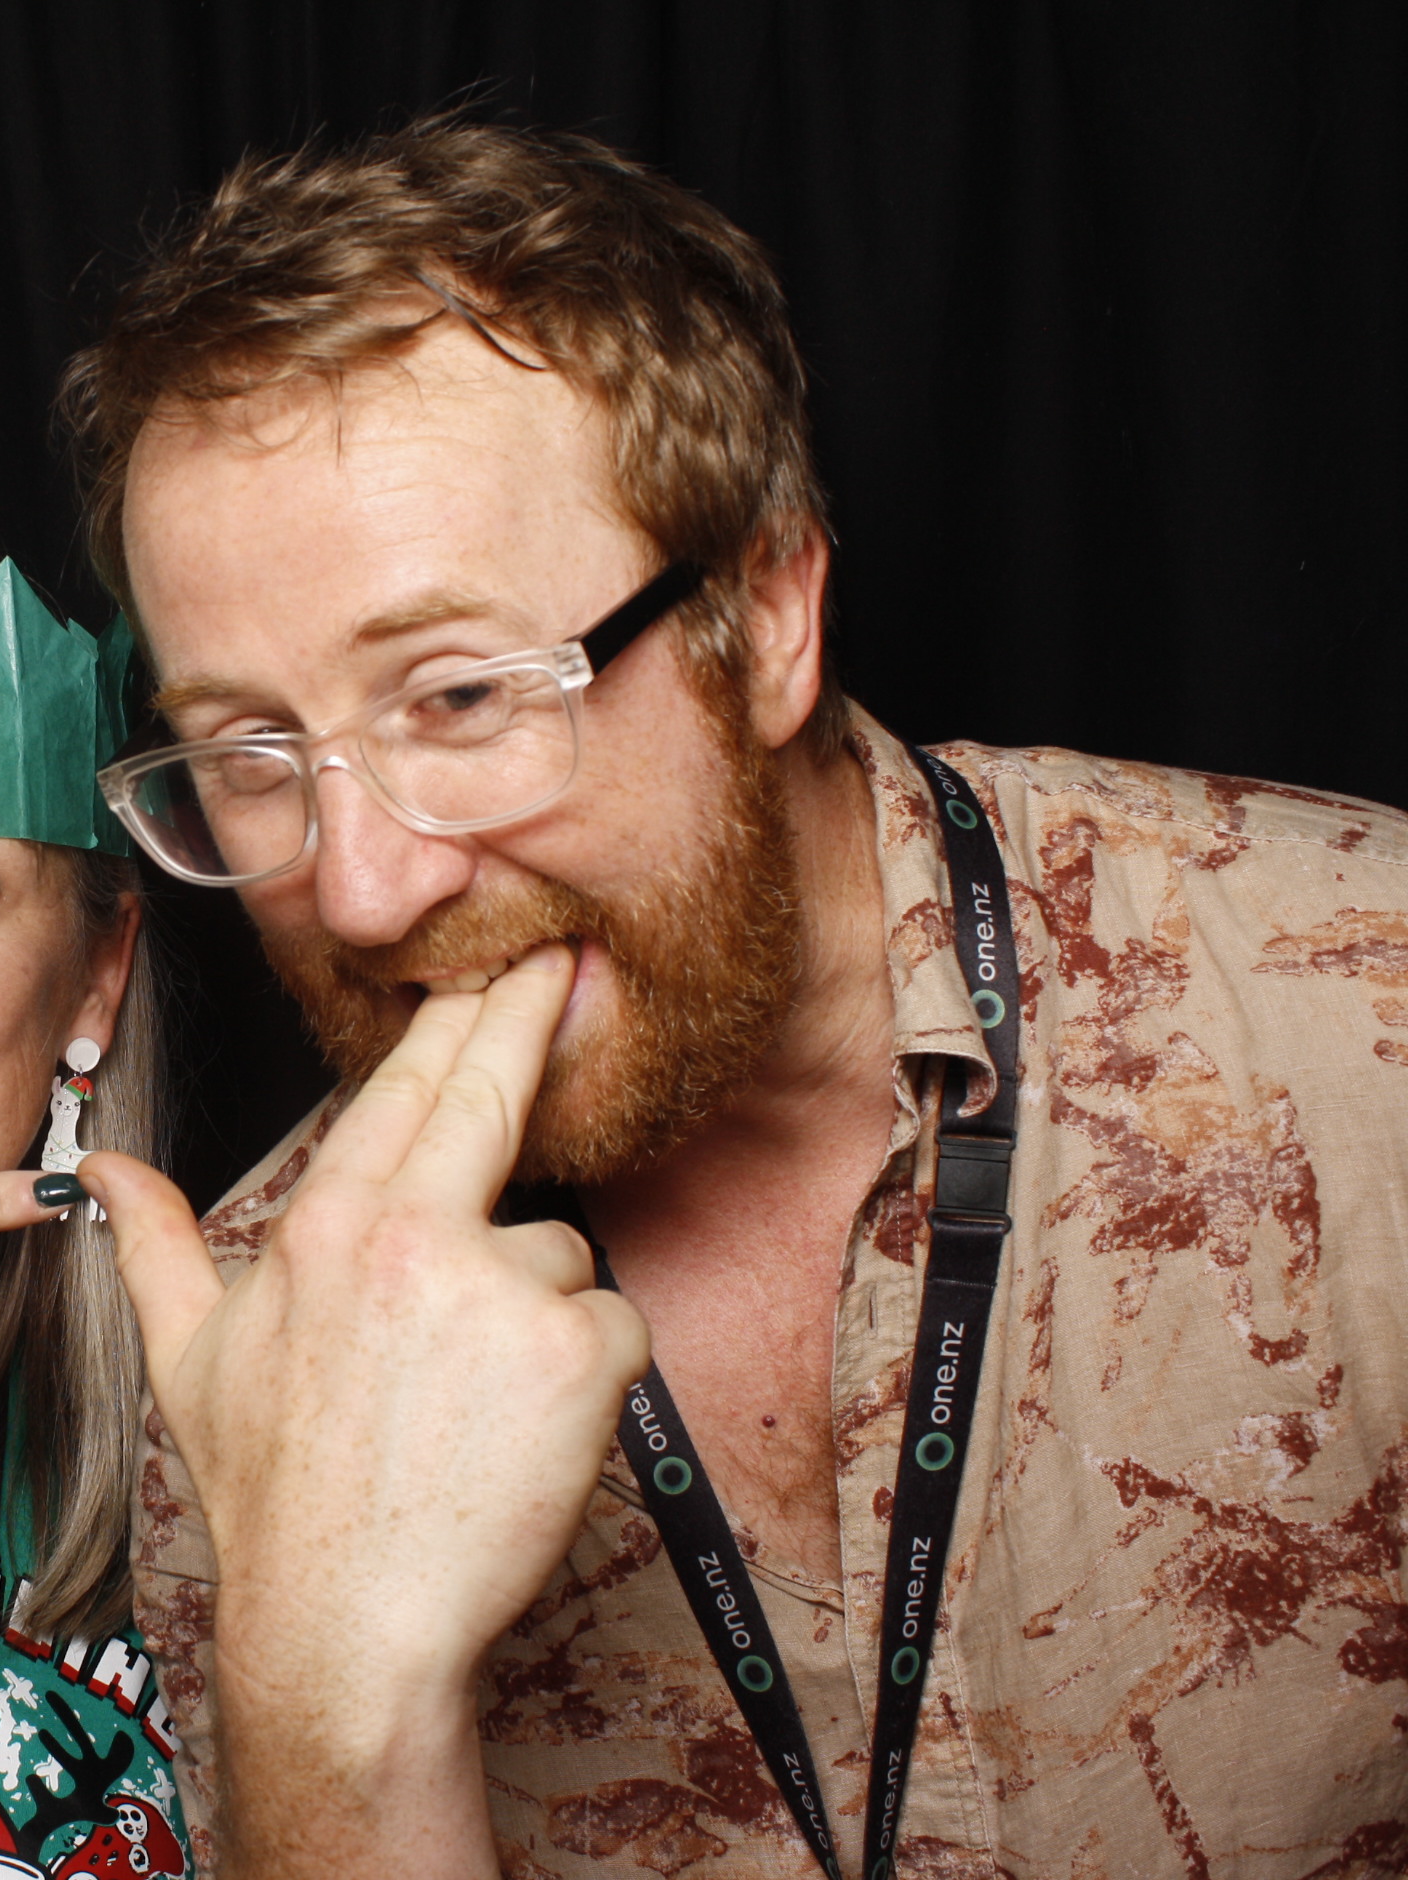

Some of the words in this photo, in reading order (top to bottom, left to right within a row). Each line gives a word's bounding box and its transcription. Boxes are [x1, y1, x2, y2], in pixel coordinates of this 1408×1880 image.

[971, 882, 996, 982] one.nz
[629, 1383, 668, 1452] one.
[930, 1321, 964, 1425] one.nz
[697, 1551, 751, 1649] one.nz
[902, 1536, 931, 1639] one.nz
[783, 1752, 829, 1850] one.nz
[880, 1748, 902, 1849] one.nz
